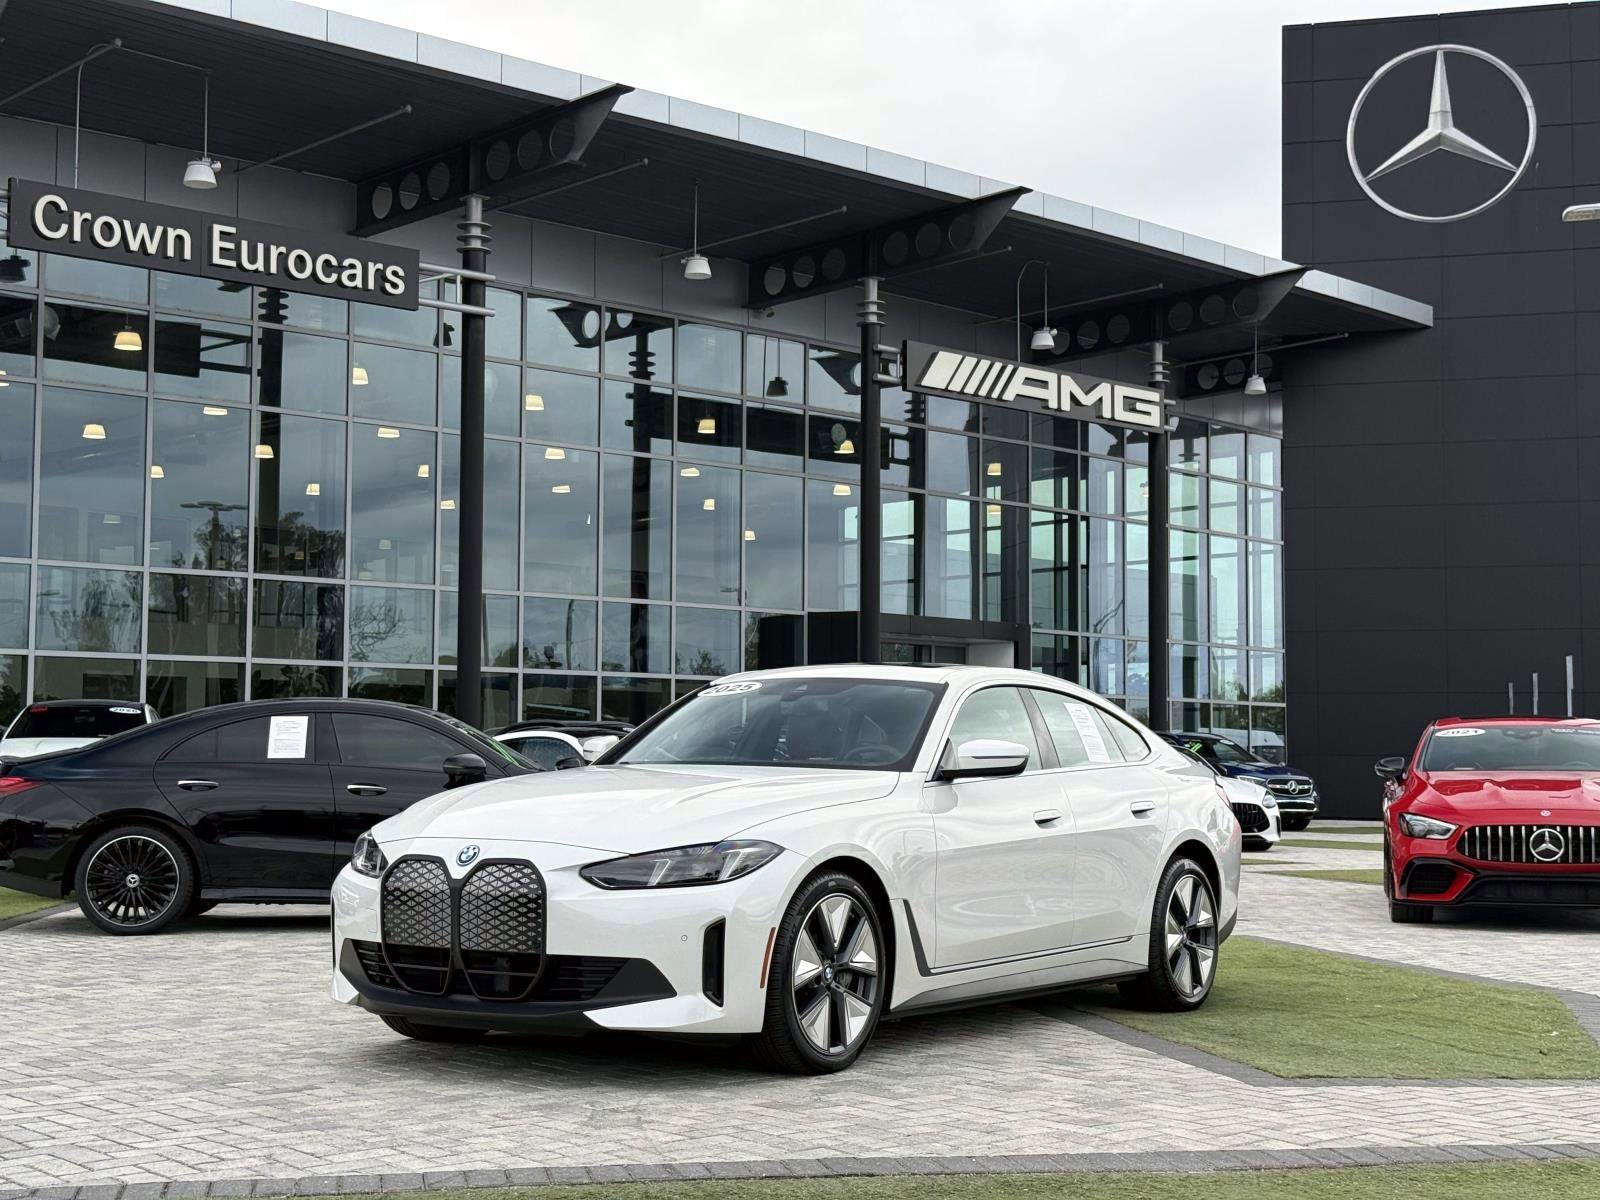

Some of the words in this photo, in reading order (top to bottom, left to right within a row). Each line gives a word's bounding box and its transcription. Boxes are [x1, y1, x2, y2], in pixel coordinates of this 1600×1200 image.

[33, 194, 192, 260] Crown
[210, 223, 406, 295] Eurocars
[1002, 366, 1160, 427] AMG
[703, 683, 757, 695] 2025
